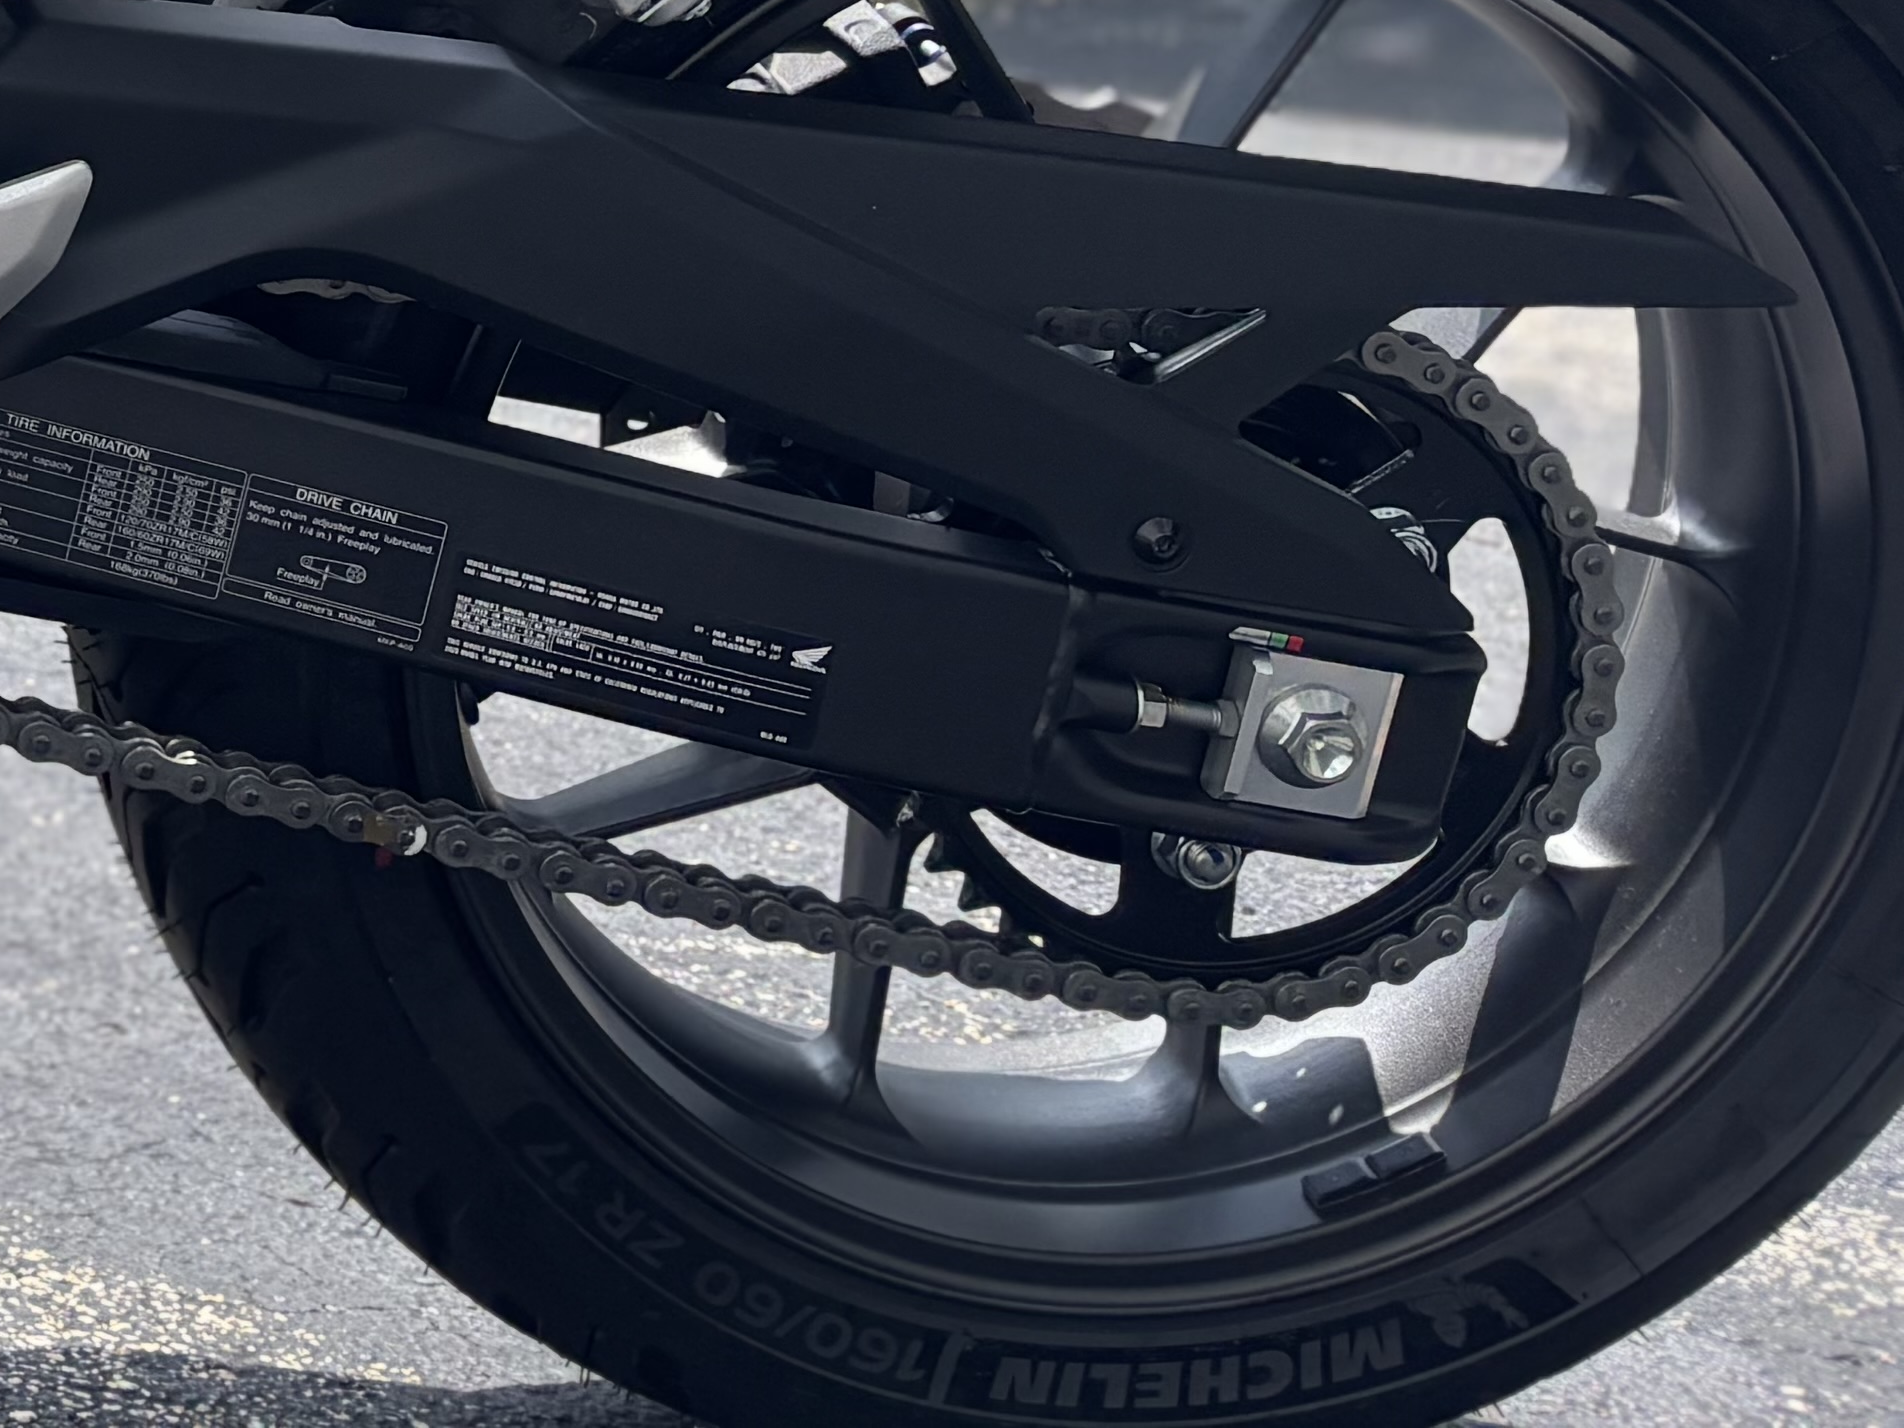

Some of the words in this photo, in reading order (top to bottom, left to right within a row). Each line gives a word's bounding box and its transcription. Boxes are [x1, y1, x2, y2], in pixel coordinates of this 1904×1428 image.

[4, 412, 40, 433] TIRE
[45, 423, 151, 461] INFORMATION
[247, 499, 275, 515] Keep
[279, 507, 308, 522] chain
[311, 515, 355, 535] adjusted
[358, 527, 379, 540] and
[382, 534, 435, 555] lubricated.
[294, 487, 343, 511] DRIVE
[348, 501, 399, 525] CHAIN
[245, 511, 260, 523] 30
[260, 516, 280, 527] mm
[298, 525, 314, 536] 1/4
[335, 535, 381, 555] Freeplay
[275, 567, 320, 587] Freeplay
[294, 599, 334, 617] owner's
[525, 1137, 590, 1193] 17
[594, 1190, 686, 1270] ZR
[692, 1260, 927, 1381] 160/60
[989, 1316, 1404, 1408] MICHELIN
